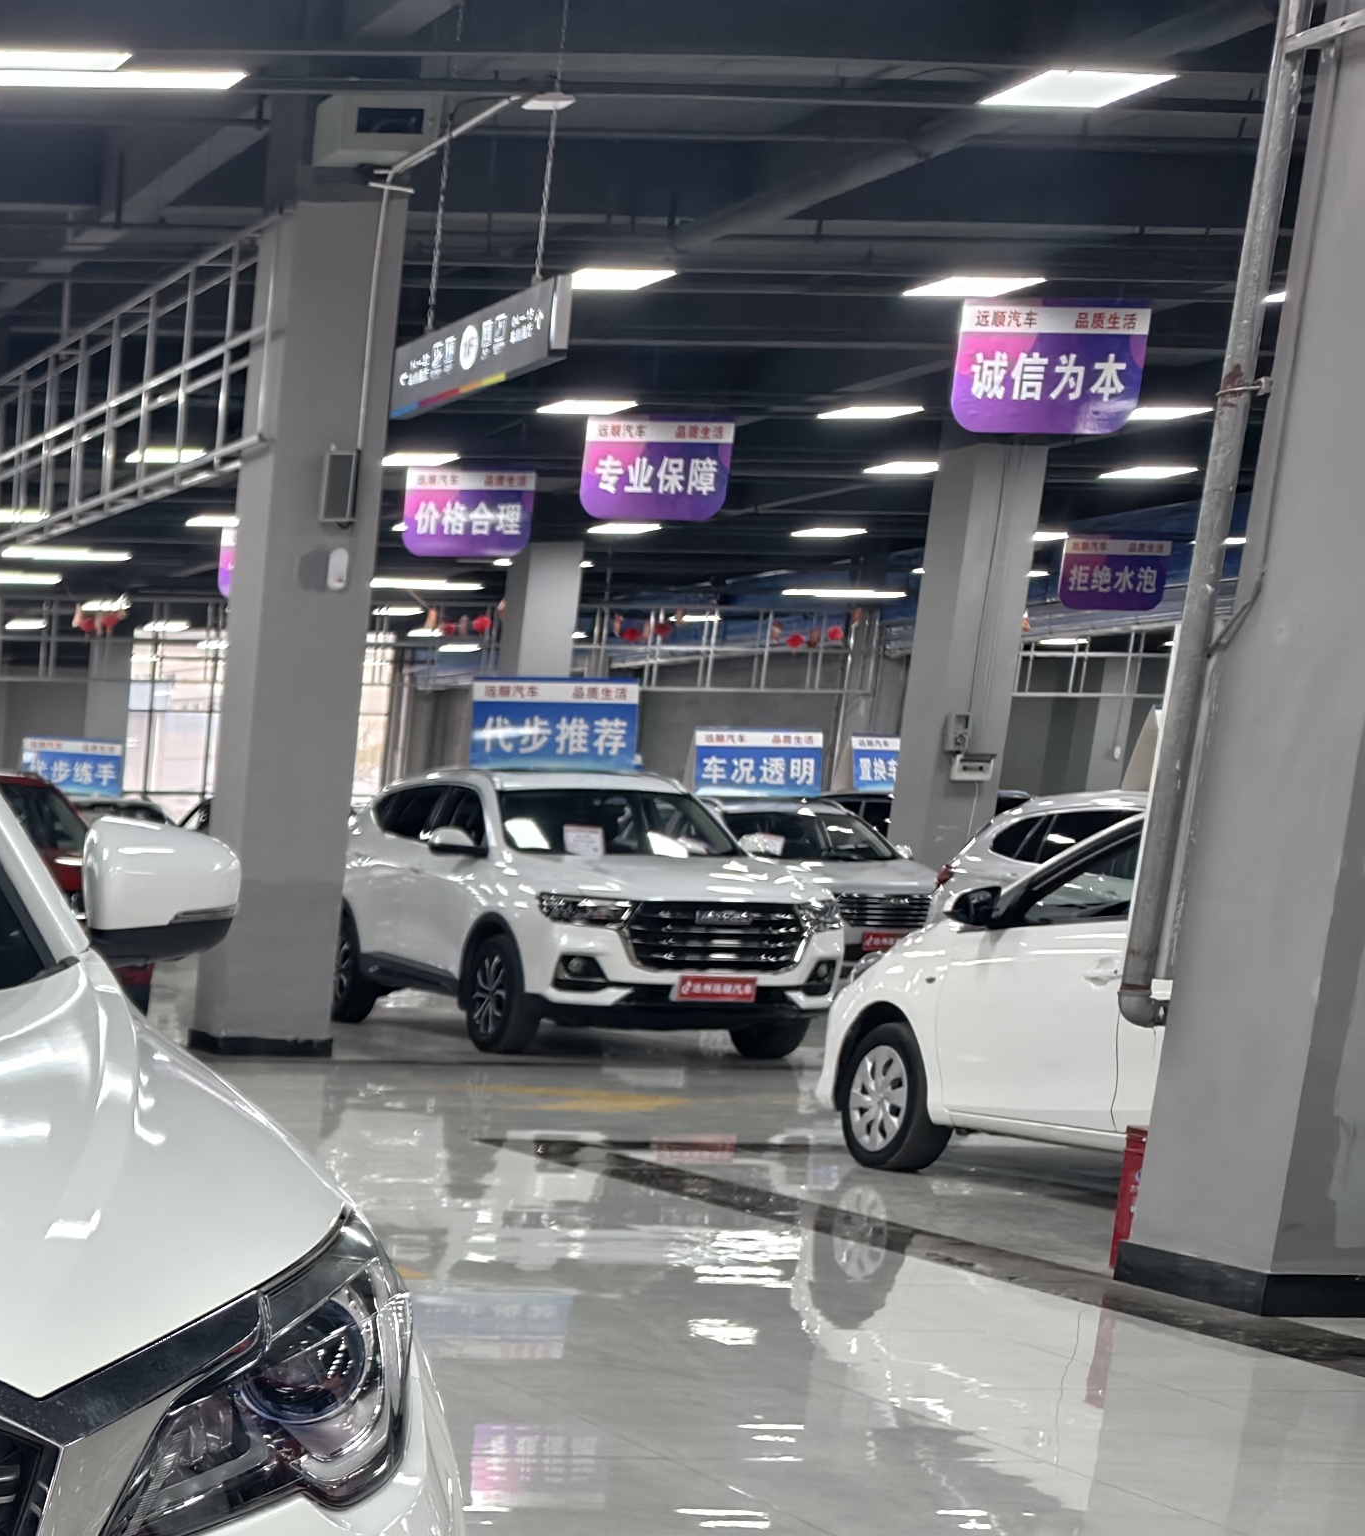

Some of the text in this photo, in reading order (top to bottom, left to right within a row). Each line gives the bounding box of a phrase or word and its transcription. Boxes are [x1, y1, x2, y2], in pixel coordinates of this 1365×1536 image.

[975, 310, 1138, 330] 远顺汽车 品质生活
[971, 350, 1127, 402] 诚信为本
[594, 454, 718, 495] 专业保障
[414, 500, 522, 536] 价格合理
[1068, 564, 1158, 594] 拒绝水泡
[482, 714, 629, 757] 代步推荐
[700, 755, 816, 786] 车况透明
